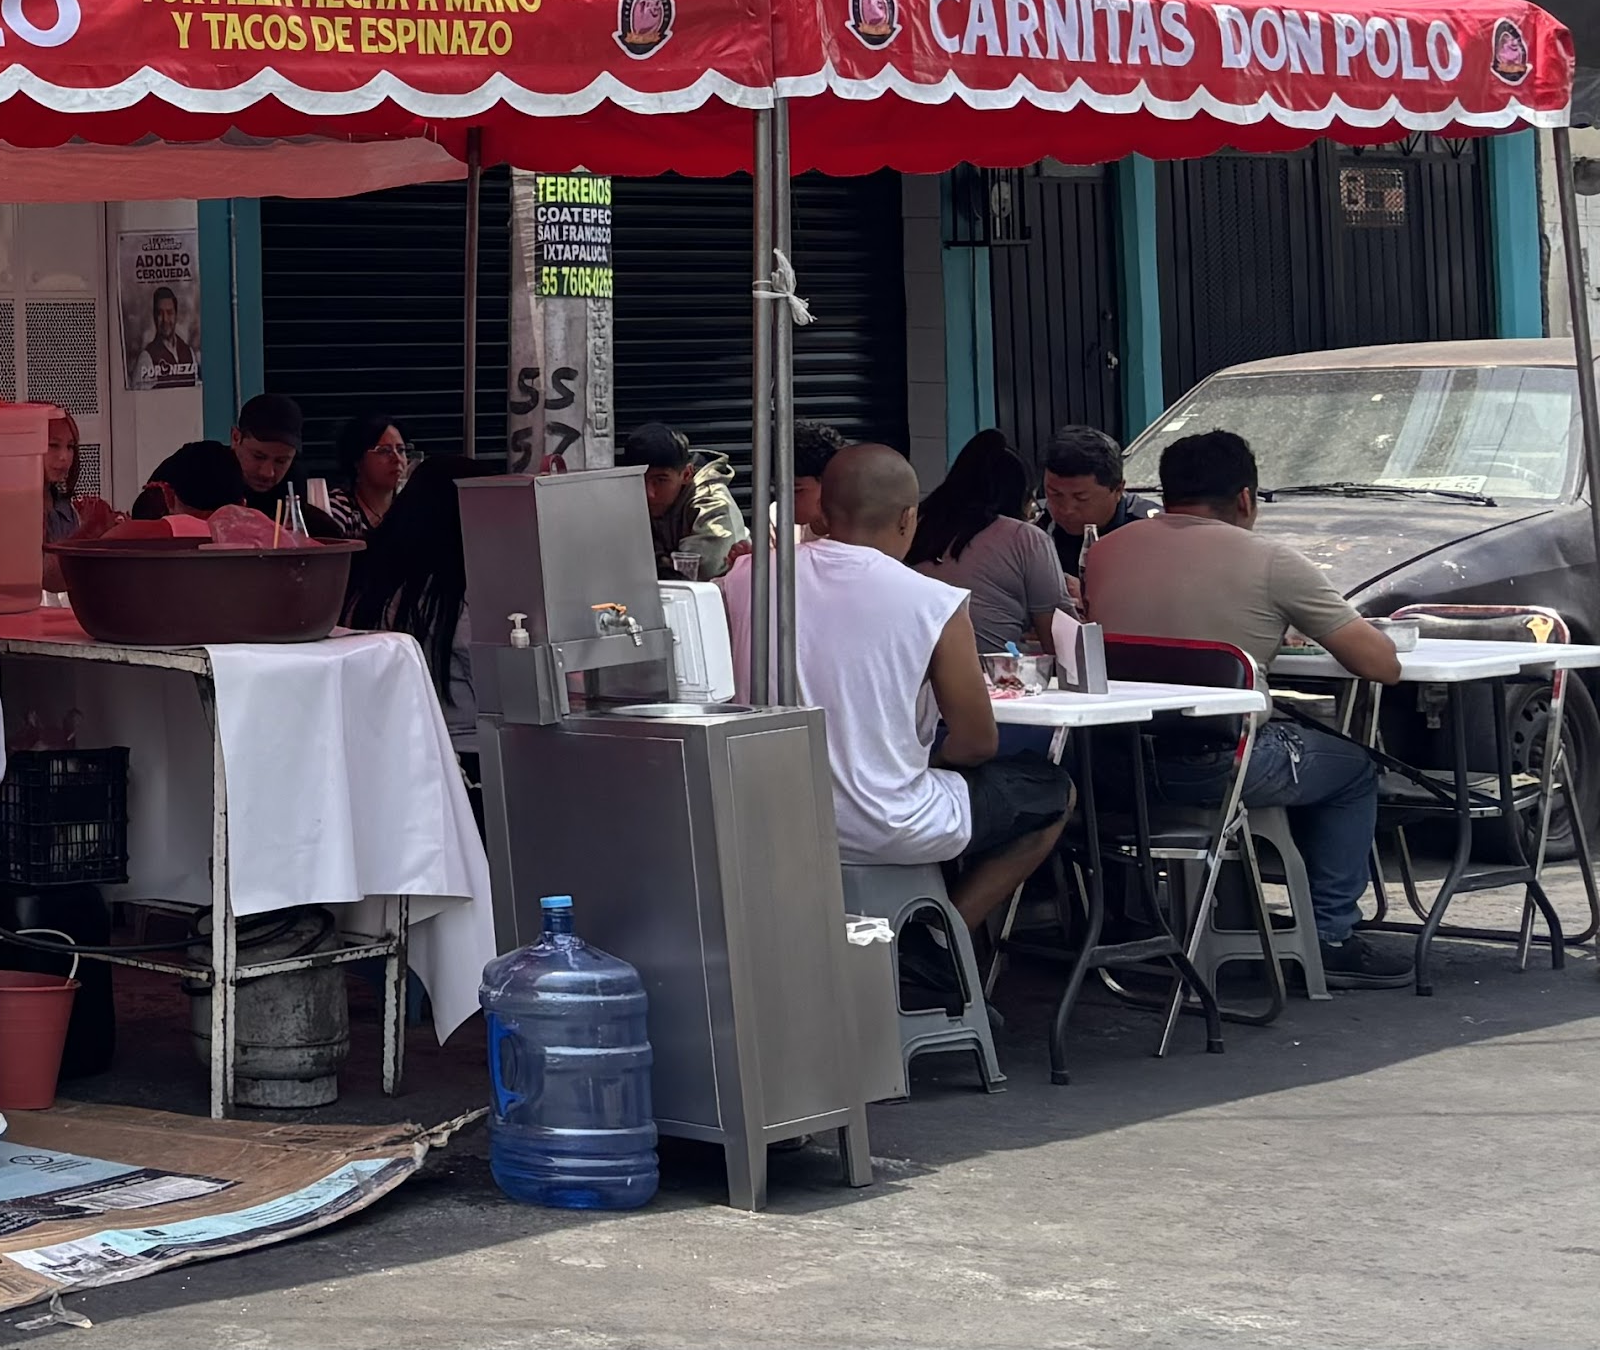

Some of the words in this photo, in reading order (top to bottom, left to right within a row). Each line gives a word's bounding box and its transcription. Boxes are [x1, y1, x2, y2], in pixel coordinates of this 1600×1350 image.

[170, 11, 193, 48] Y
[201, 12, 308, 52] TACOS
[314, 17, 353, 53] DE
[358, 18, 515, 57] ESPINAZO
[1217, 3, 1326, 77] DON
[1333, 12, 1464, 83] POLO
[536, 175, 612, 206] TERRENOS
[537, 206, 612, 224] COATEPEC
[562, 224, 612, 244] FRANCISCO
[135, 252, 191, 269] ADOLFO
[543, 243, 609, 262] IXTAPALUCA
[135, 267, 192, 281] CERQUEDA
[542, 265, 558, 296] 55
[171, 362, 198, 376] NEZA
